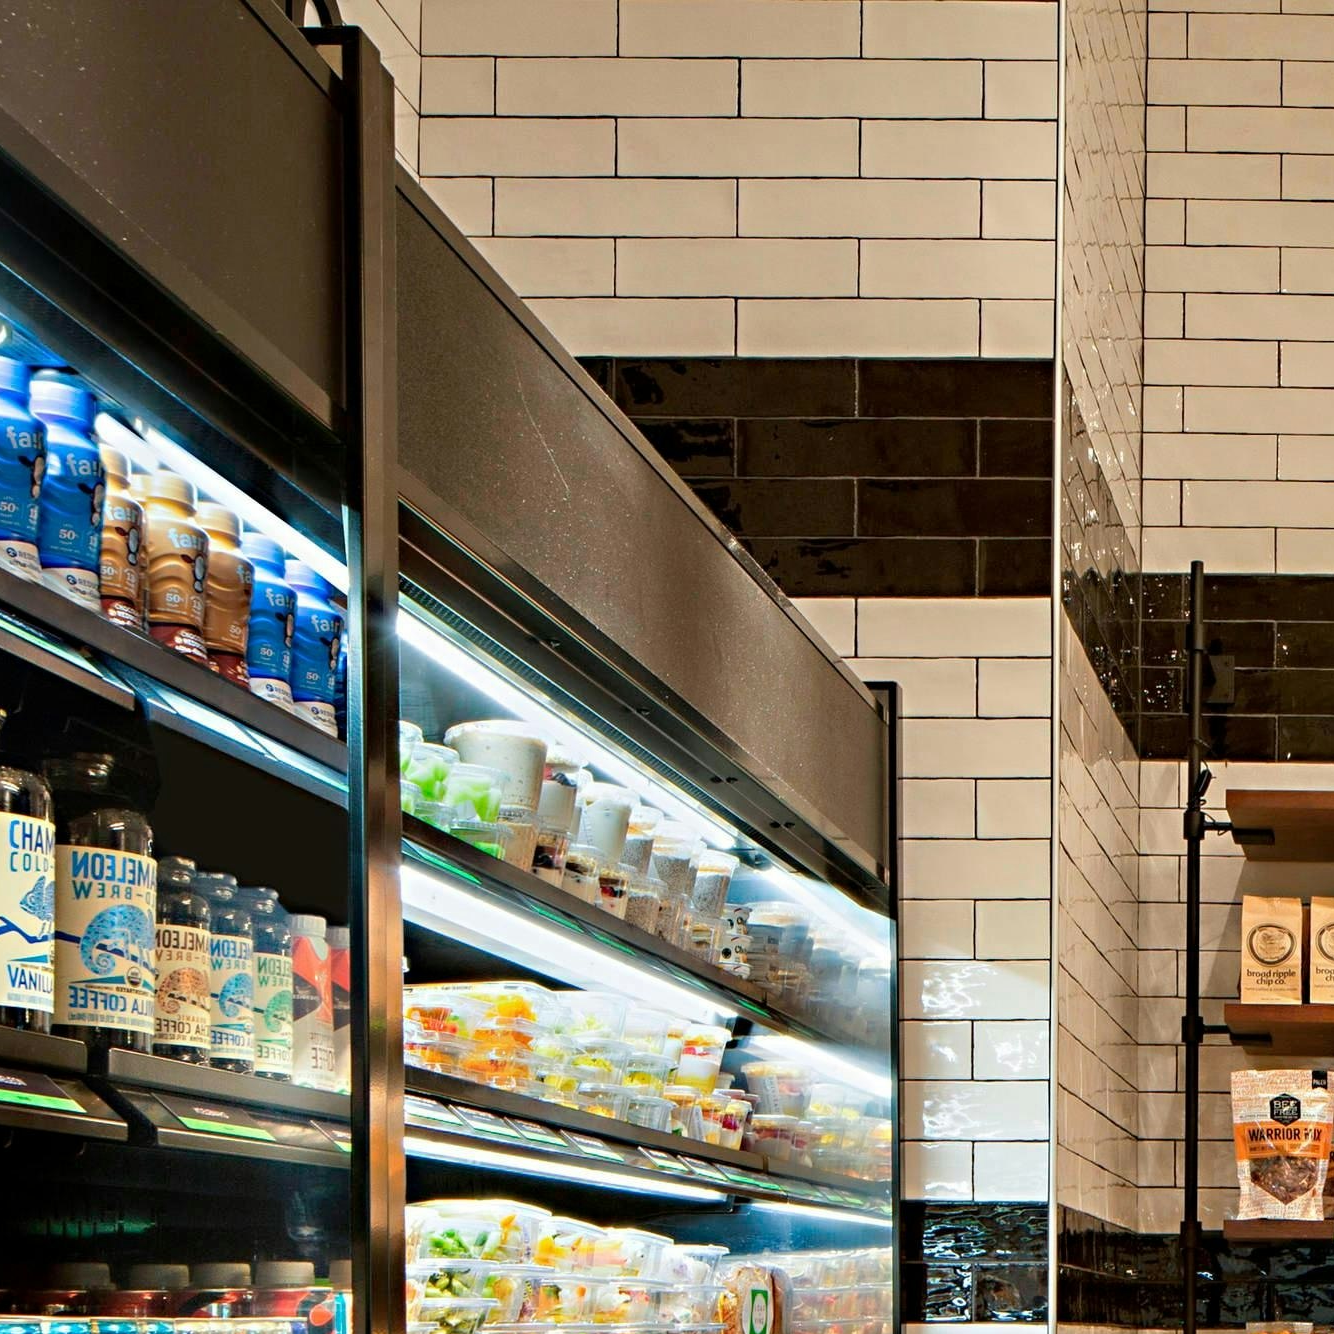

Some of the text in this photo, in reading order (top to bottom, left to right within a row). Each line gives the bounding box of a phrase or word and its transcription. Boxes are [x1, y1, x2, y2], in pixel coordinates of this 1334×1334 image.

[1246, 968, 1296, 980] broad ripple
[1256, 976, 1286, 987] chip co.
[1273, 1108, 1298, 1116] FREE
[1248, 1128, 1300, 1142] WARRIOR
